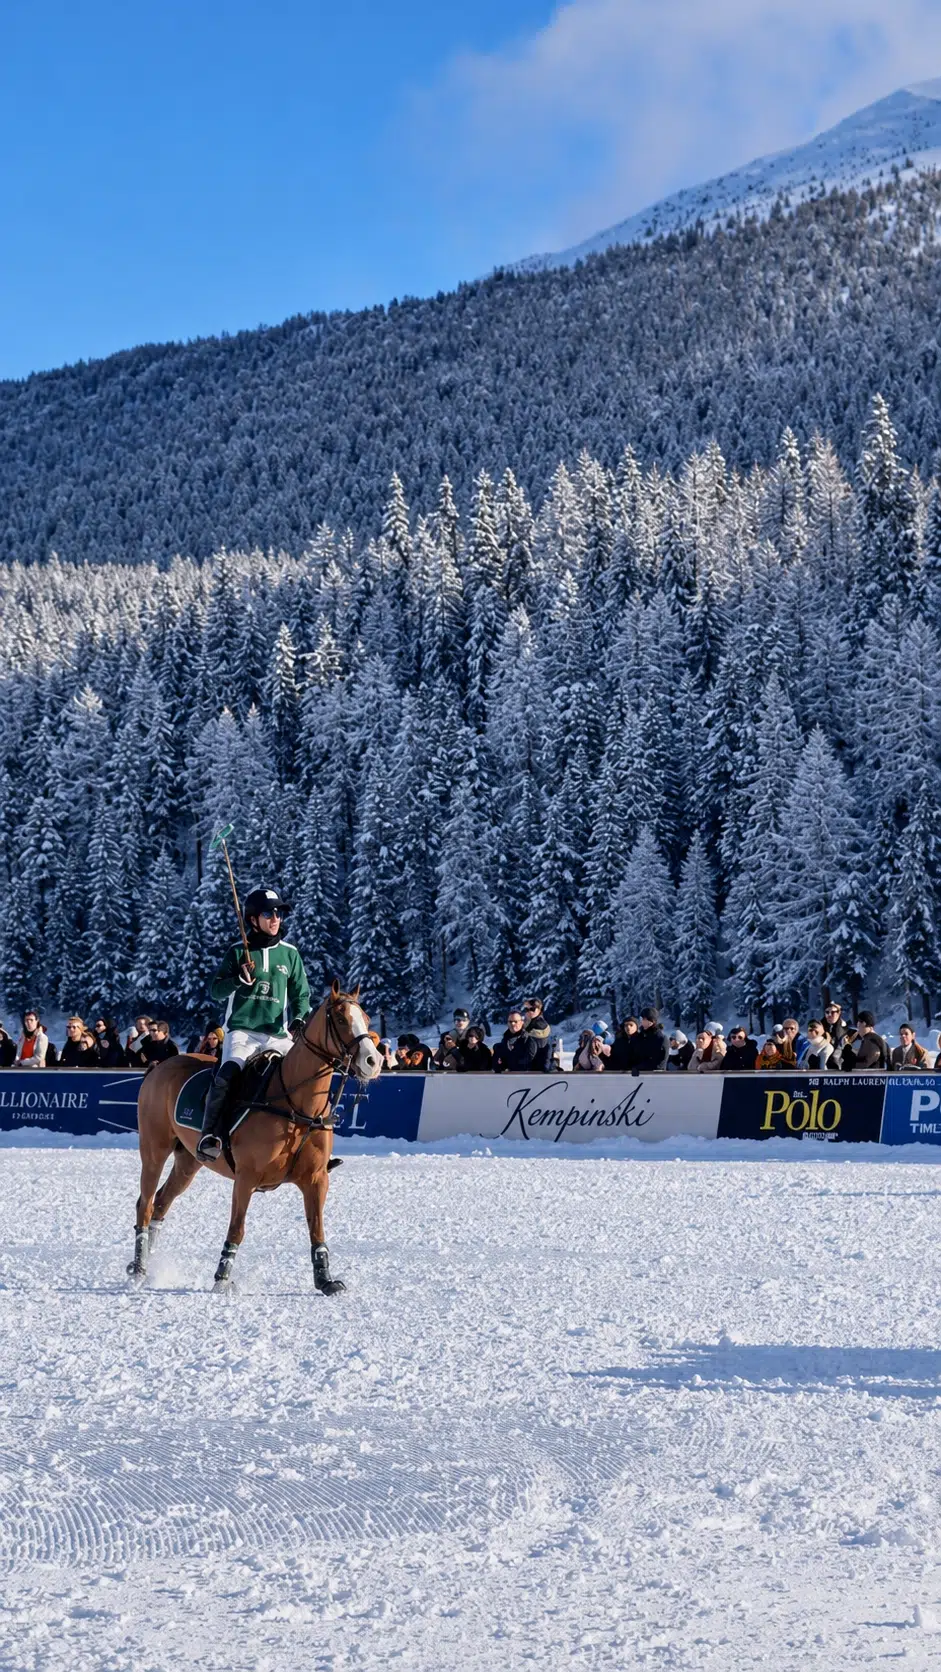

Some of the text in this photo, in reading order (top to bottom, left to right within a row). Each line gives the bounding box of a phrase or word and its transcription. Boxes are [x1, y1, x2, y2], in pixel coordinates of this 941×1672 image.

[852, 1078, 886, 1086] LAUREN
[479, 1080, 655, 1142] Kempinski
[760, 1089, 842, 1131] Polo
[909, 1089, 941, 1122] P
